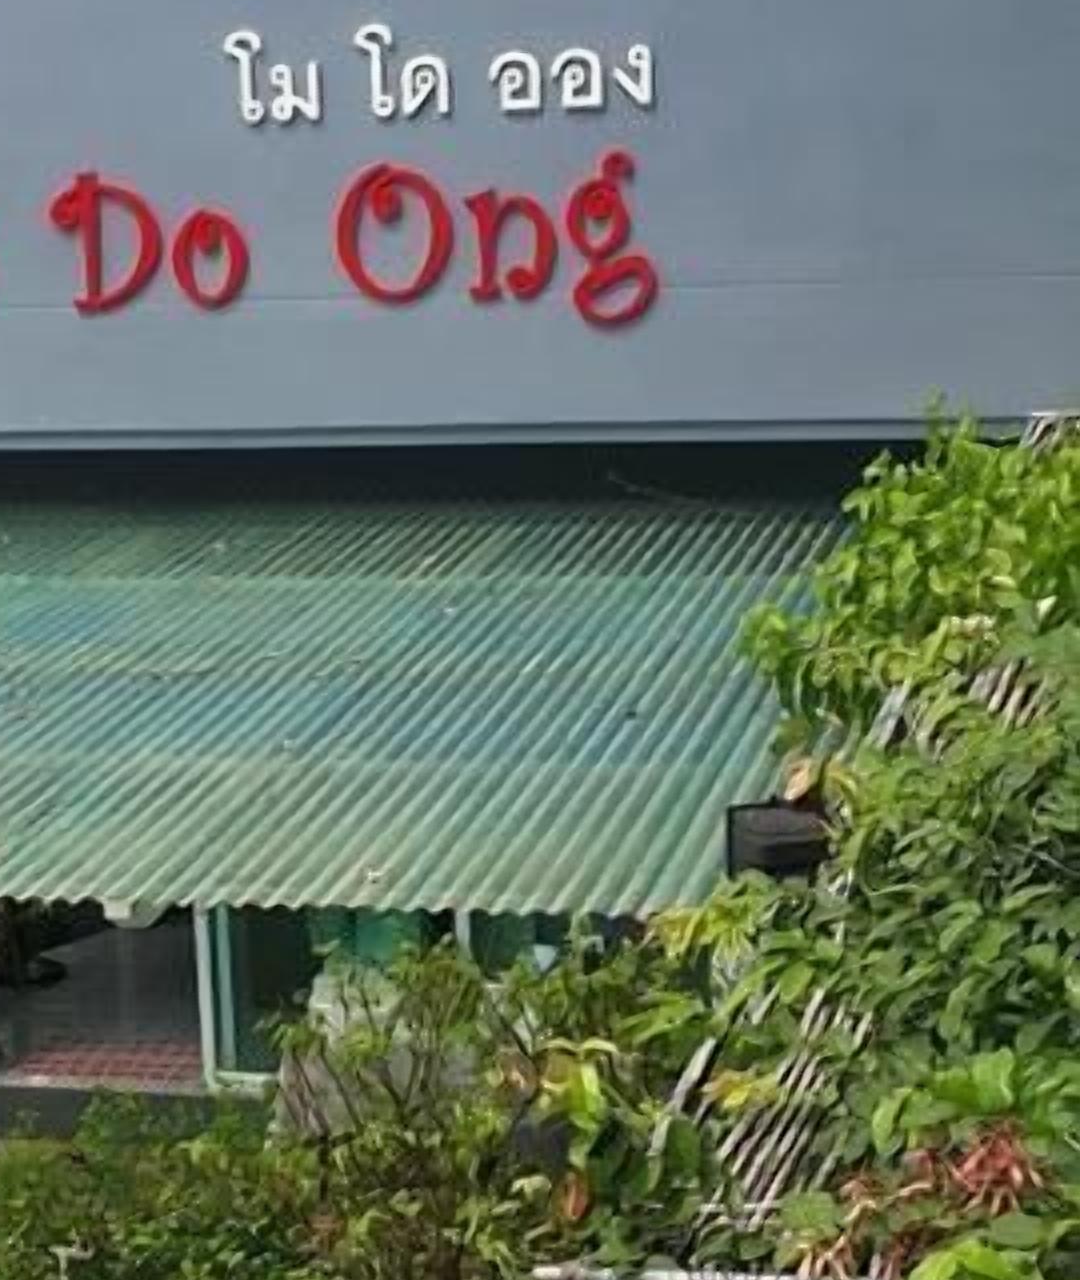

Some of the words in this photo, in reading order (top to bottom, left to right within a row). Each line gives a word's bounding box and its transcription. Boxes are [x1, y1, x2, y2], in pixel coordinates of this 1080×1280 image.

[223, 30, 319, 121] โม
[353, 23, 448, 117] โด
[489, 44, 652, 110] ออง
[46, 172, 248, 312] Do
[334, 151, 656, 325] Ong
